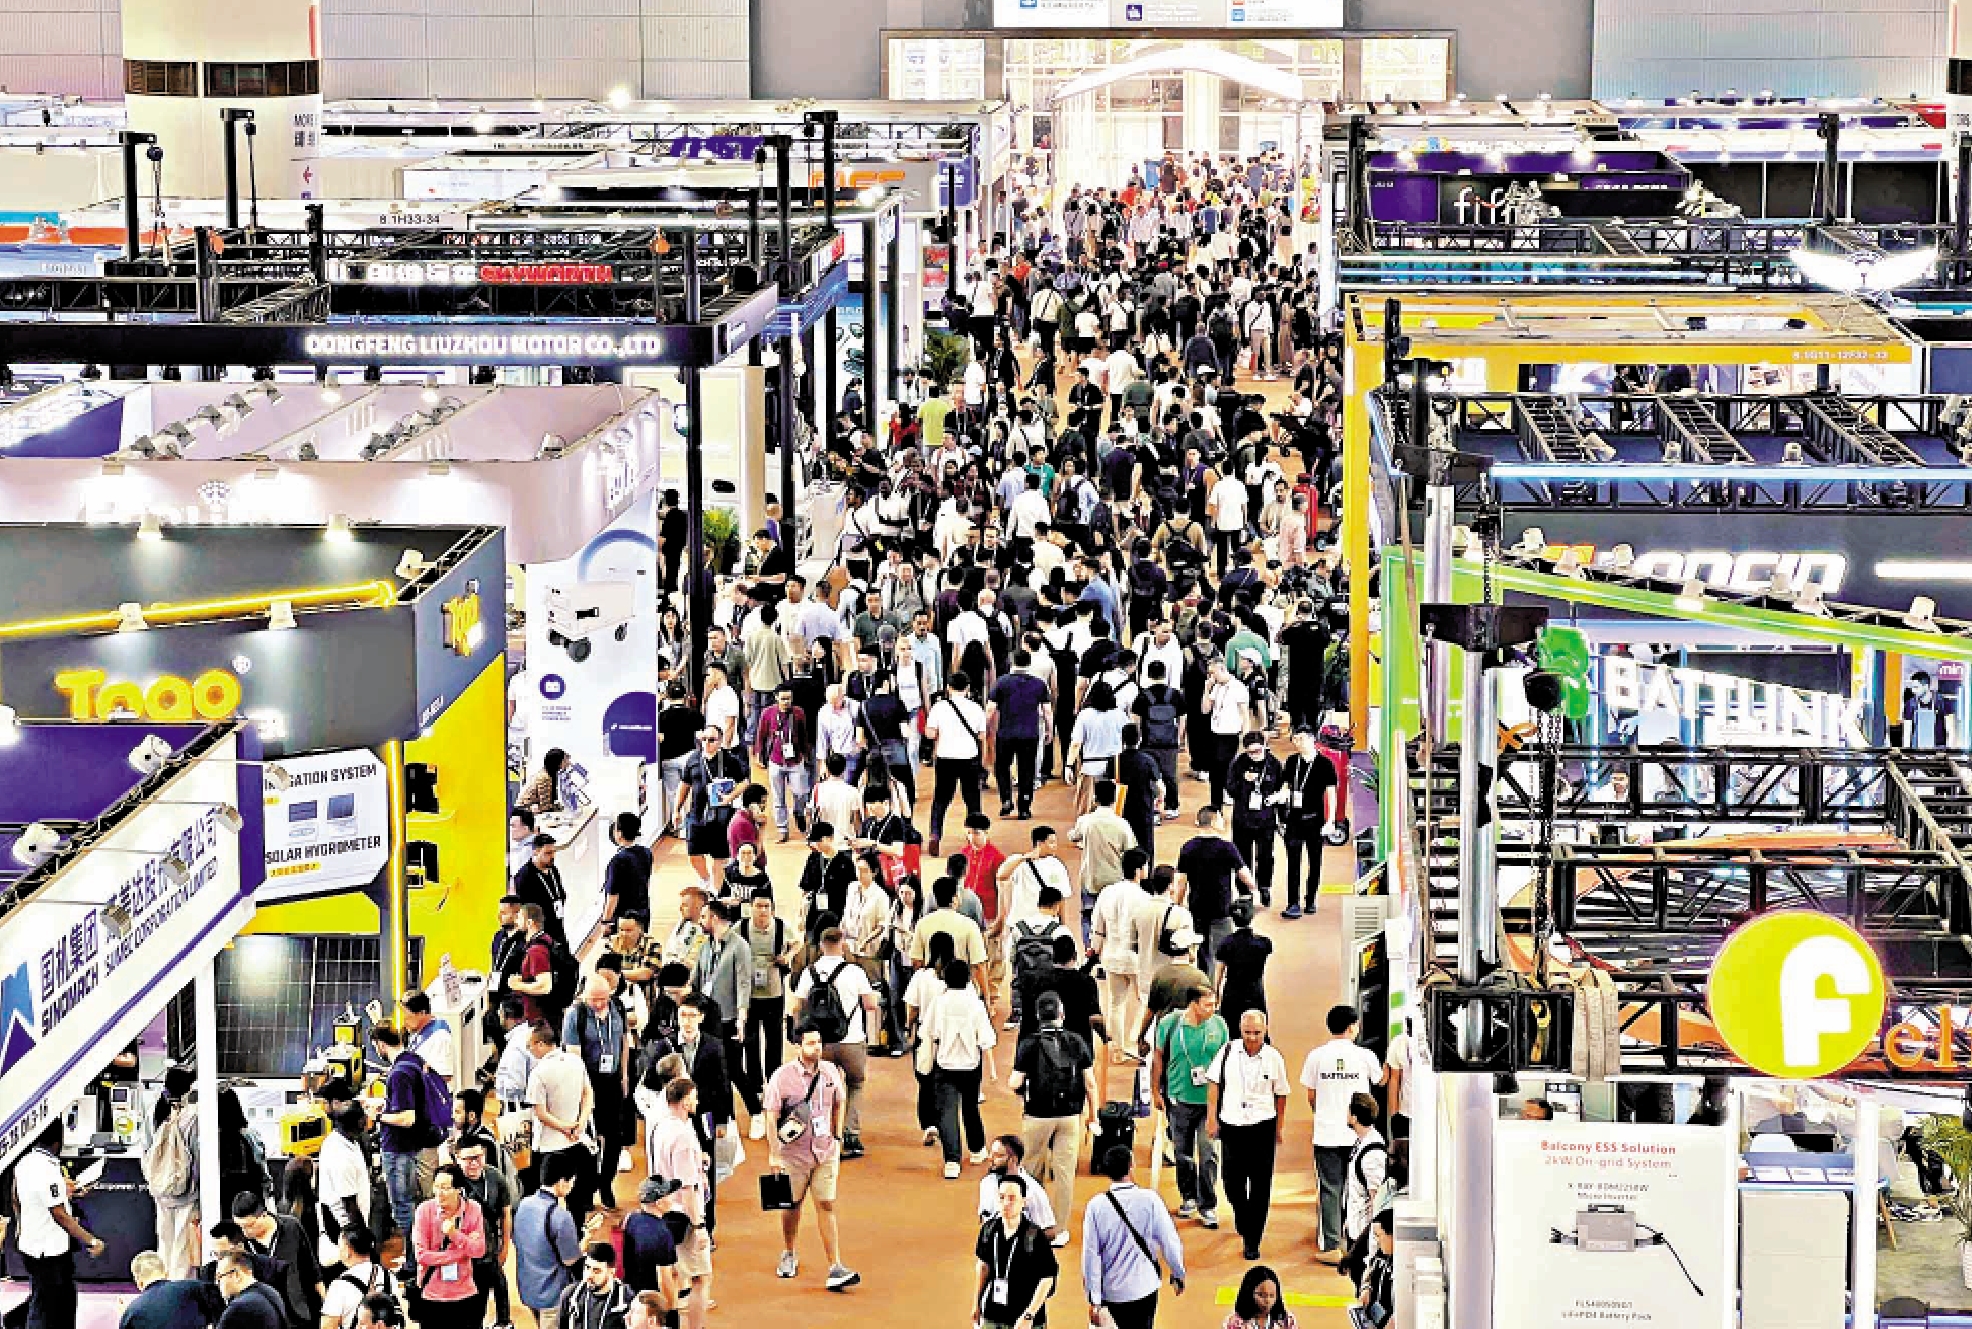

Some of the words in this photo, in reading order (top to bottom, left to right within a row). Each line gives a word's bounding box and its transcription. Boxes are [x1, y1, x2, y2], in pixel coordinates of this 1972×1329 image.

[306, 333, 418, 355] DONGFENG
[419, 333, 508, 355] LIUZHOU
[509, 333, 583, 355] MOTOR
[1603, 655, 1872, 748] BATTLINK
[330, 763, 377, 782] SYSTEM
[264, 847, 302, 865] SOLAR
[304, 835, 381, 859] HYDROMETER
[41, 907, 99, 1004] 国机集团
[41, 962, 99, 1038] SINOMACH
[1885, 1004, 1972, 1068] el
[1540, 1139, 1593, 1154] Balcony
[1595, 1141, 1618, 1153] ESS
[1621, 1142, 1677, 1155] Solution
[1626, 1157, 1672, 1170] System
